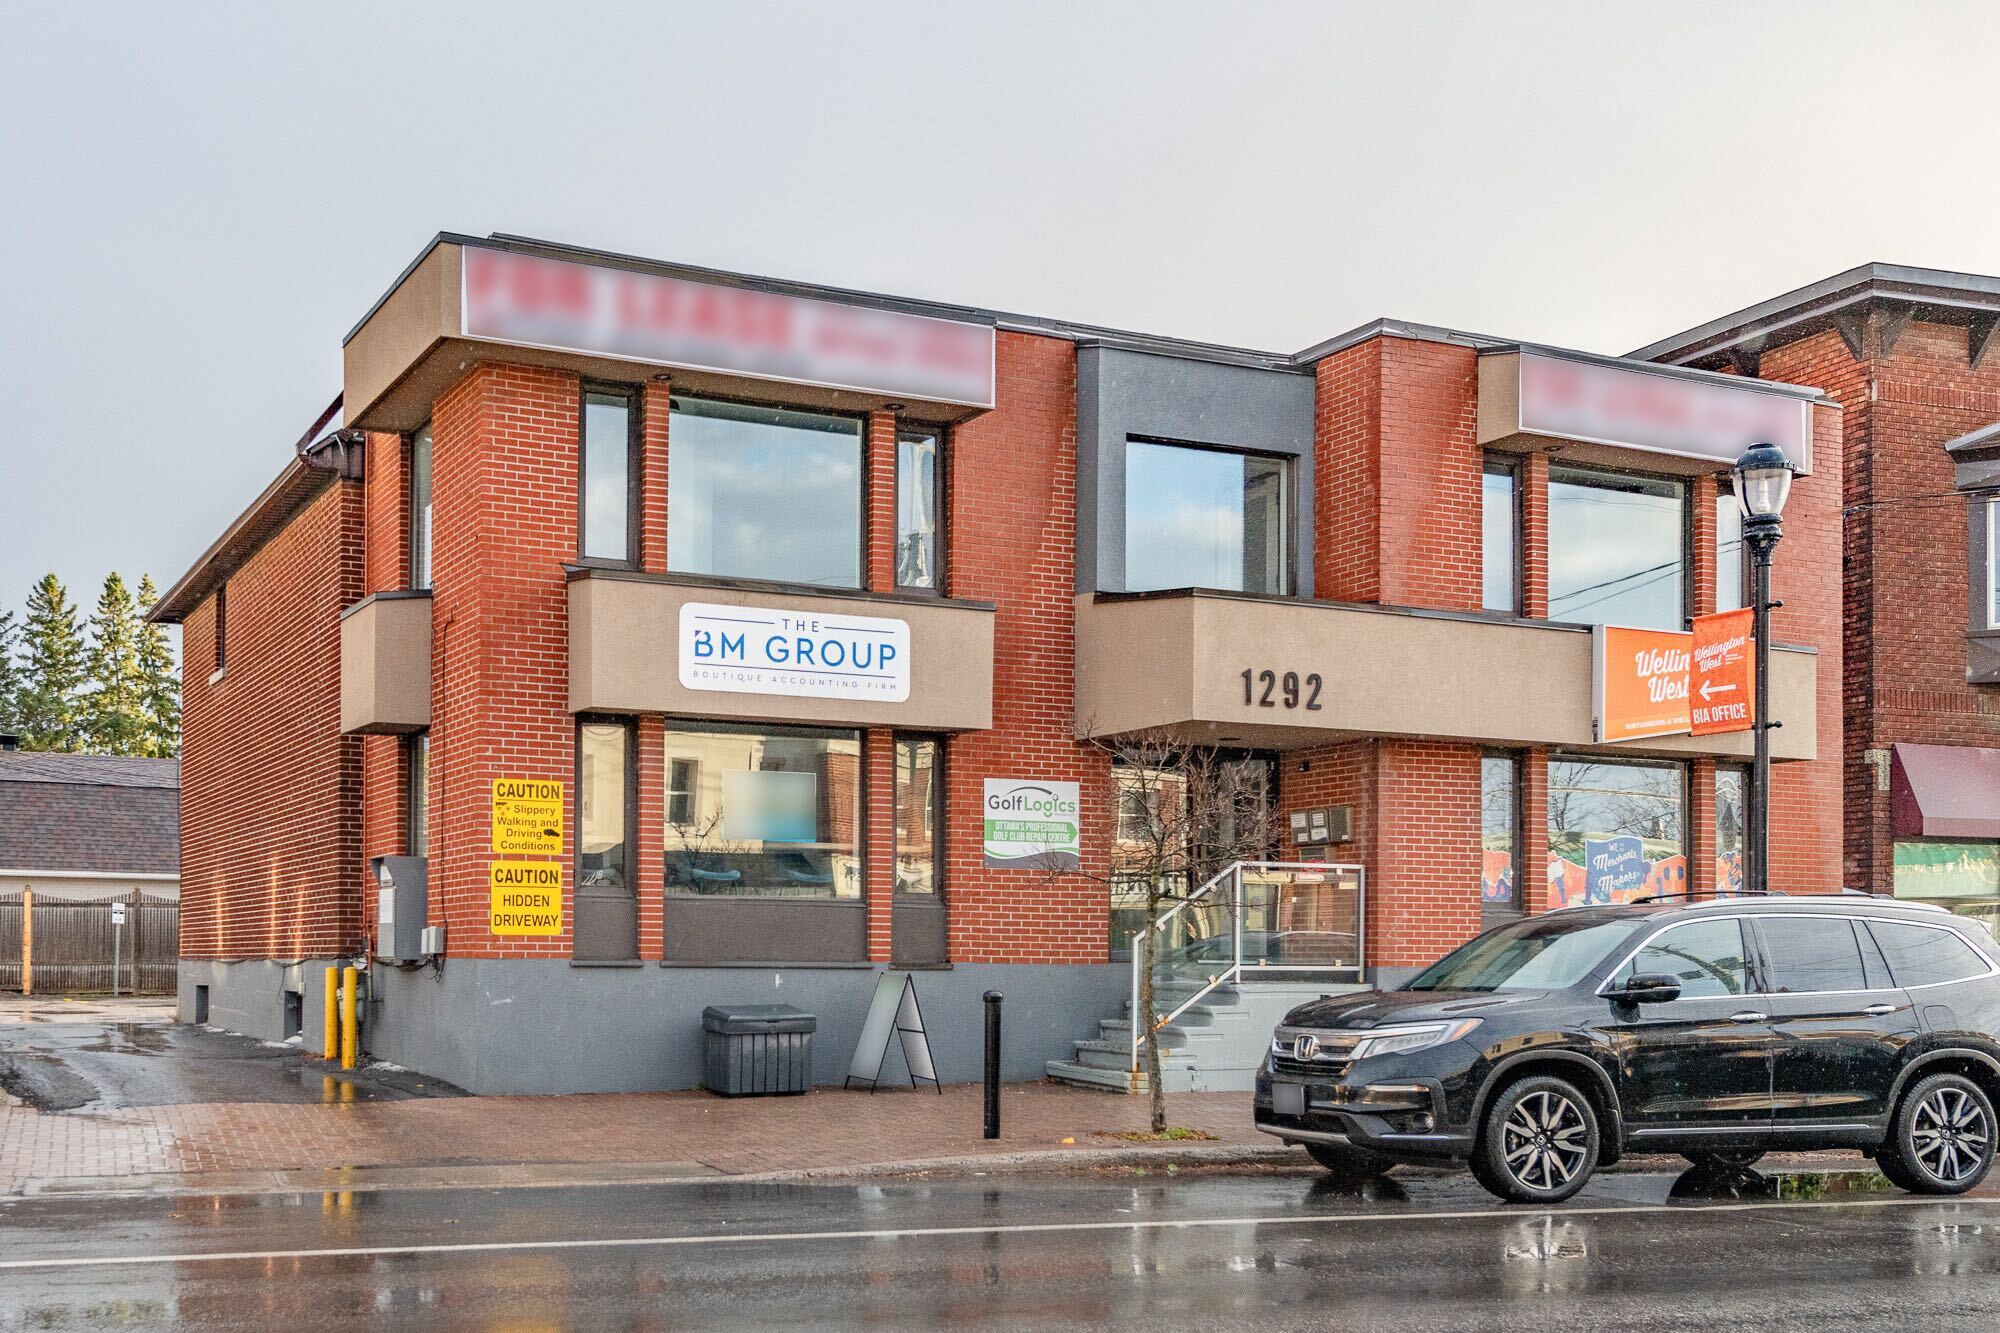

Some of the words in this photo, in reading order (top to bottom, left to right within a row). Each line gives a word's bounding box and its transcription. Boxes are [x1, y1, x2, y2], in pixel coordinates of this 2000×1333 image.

[782, 618, 820, 633] THE
[694, 630, 745, 660] BM
[765, 635, 896, 670] GROUP
[1693, 636, 1746, 662] Wellington
[1699, 654, 1723, 673] West
[693, 670, 763, 683] BOUTIQUE
[772, 675, 858, 688] ACCOUNTING
[867, 682, 897, 691] FIRM
[1648, 674, 1690, 703] West
[1241, 668, 1323, 711] 1292
[1693, 707, 1711, 725] BIA
[1711, 703, 1747, 721] OFFICE
[496, 782, 560, 800] CAUTION
[514, 804, 556, 817] Slippery
[988, 793, 1076, 818] GolfLogics
[497, 816, 537, 828] Walking
[540, 818, 559, 827] and
[1025, 821, 1068, 833] PROFESSIONAL
[506, 828, 542, 840] Driving
[993, 830, 1009, 841] GOLF
[1009, 831, 1025, 841] CLUB
[1047, 832, 1071, 843] CENTRE
[500, 840, 556, 851] Conditions
[494, 868, 559, 885] CAUTION
[1598, 871, 1637, 892] Makers
[503, 894, 550, 907] HIDDEN
[494, 913, 559, 927] DRIVEWAY
